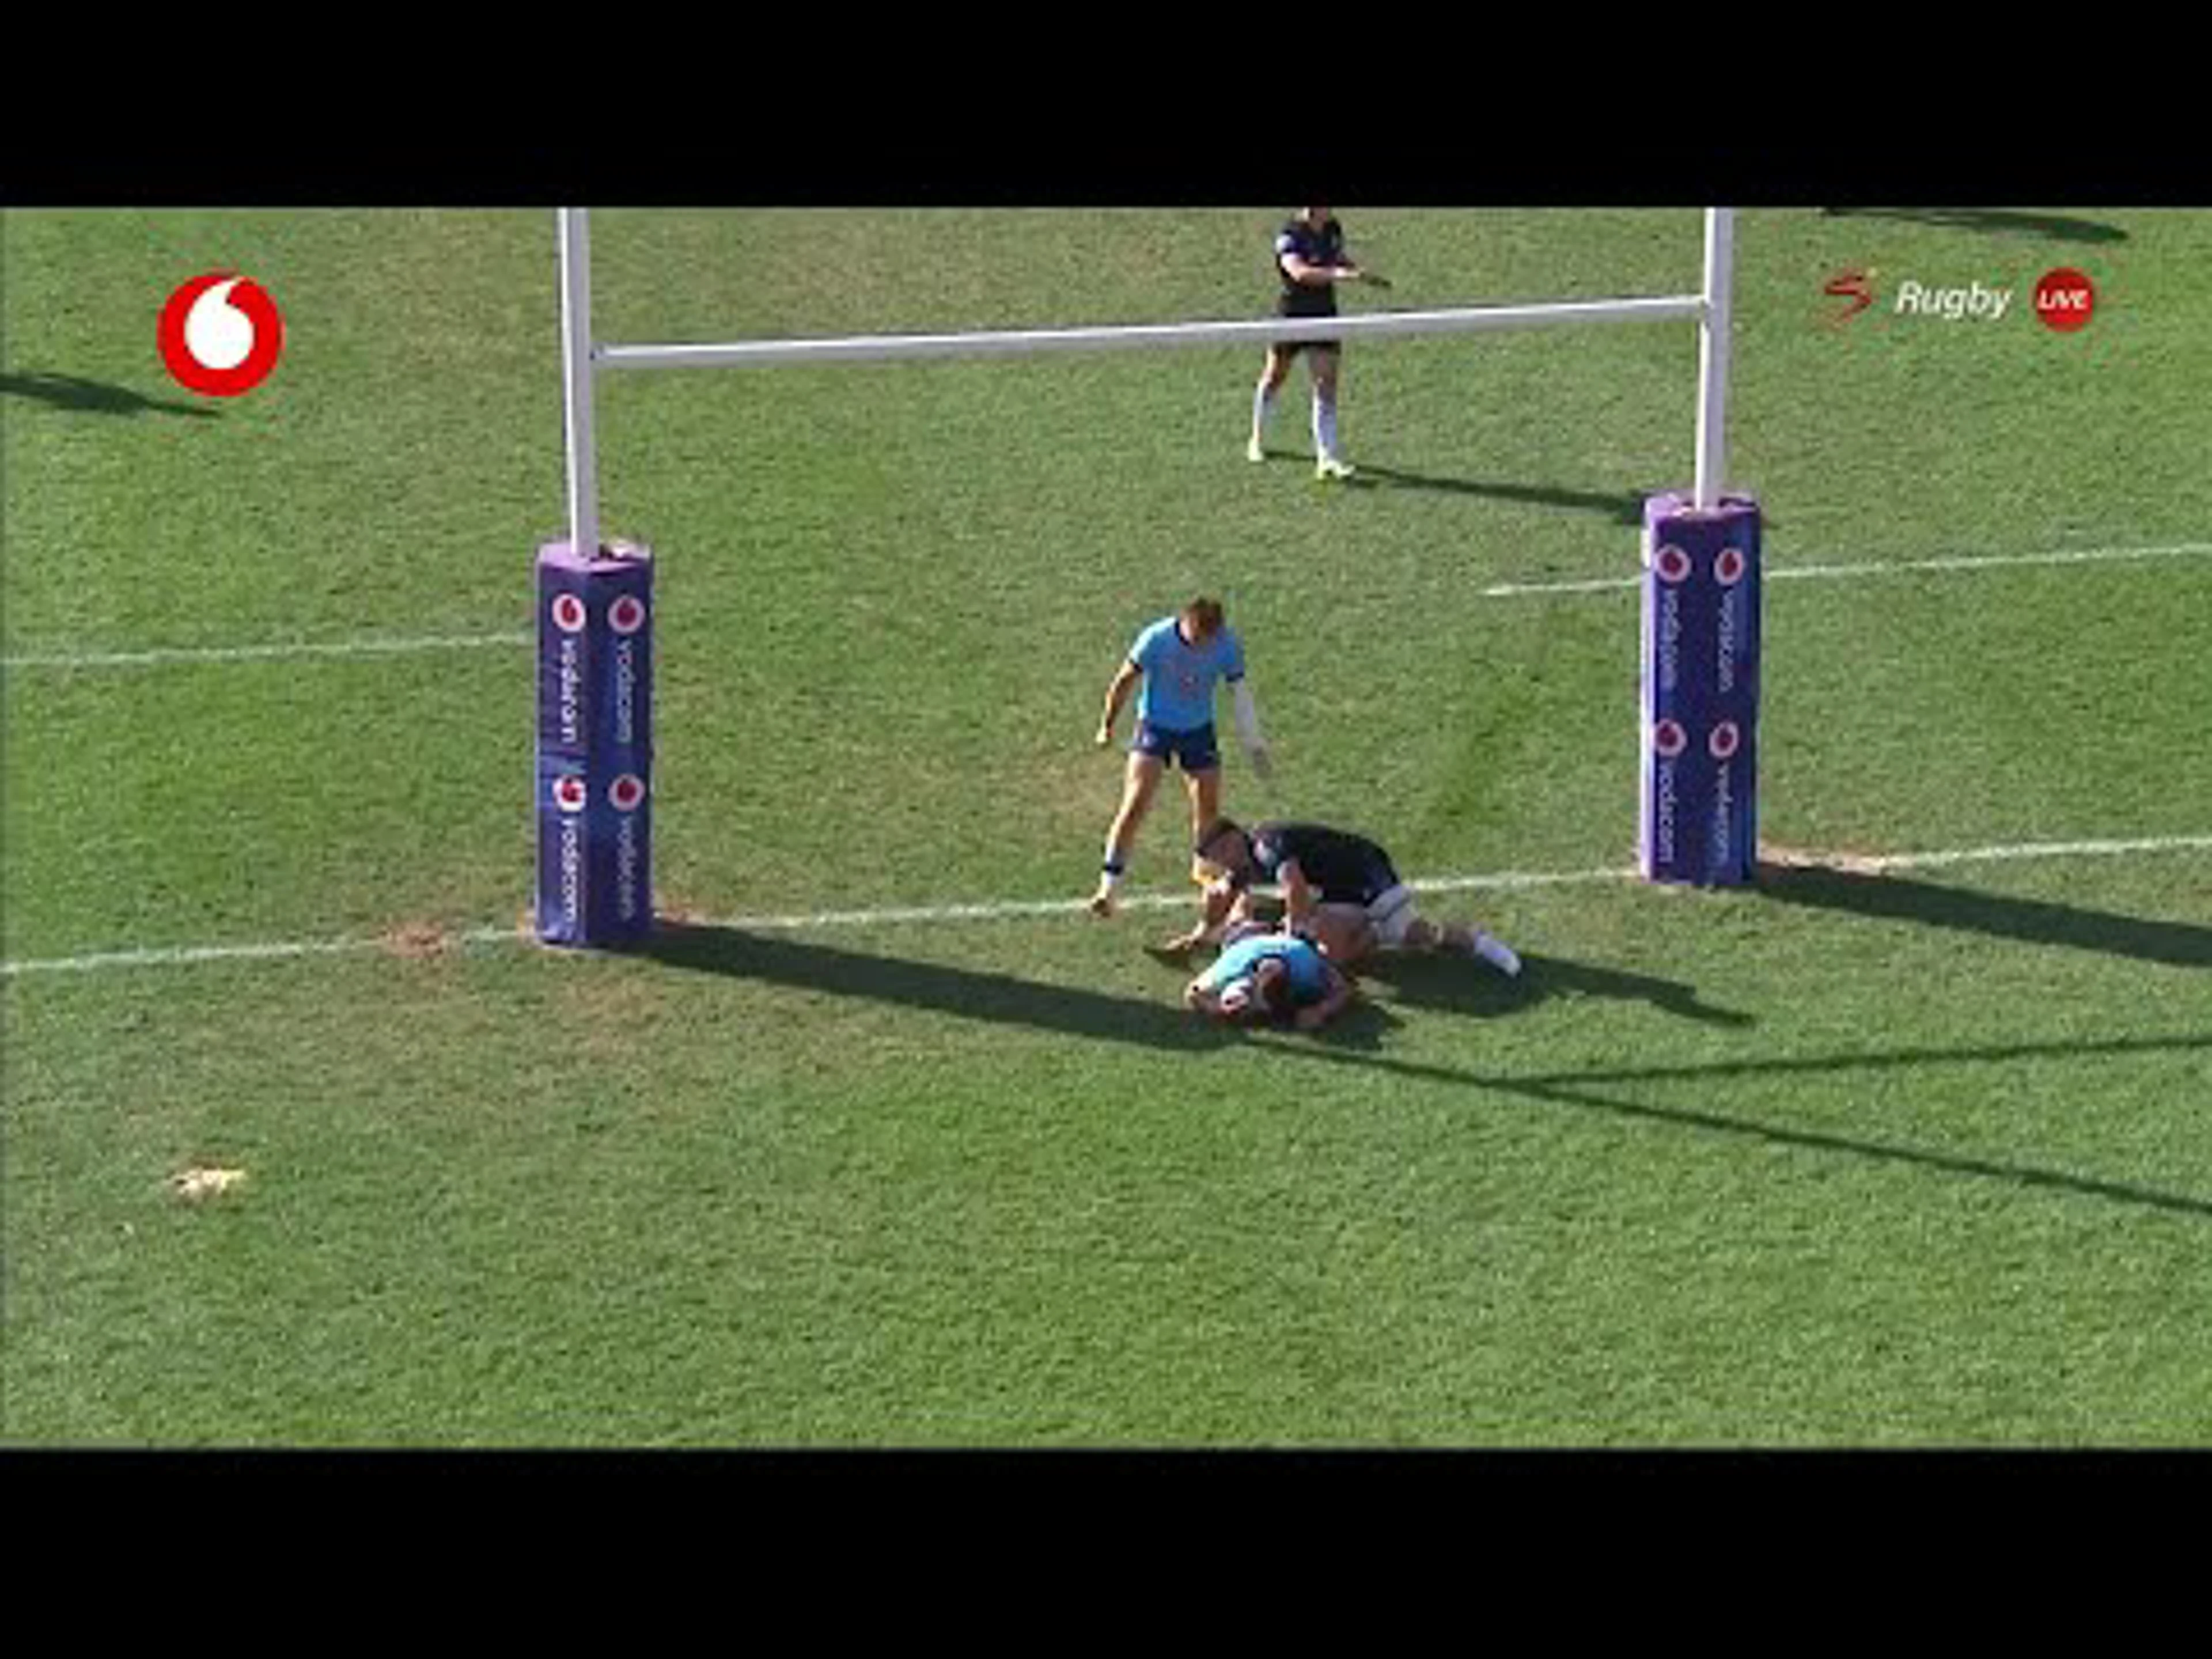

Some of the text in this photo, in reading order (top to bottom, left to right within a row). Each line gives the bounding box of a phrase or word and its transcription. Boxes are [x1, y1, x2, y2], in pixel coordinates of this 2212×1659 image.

[560, 640, 579, 743] vodacom
[616, 640, 636, 743] vodacom
[1658, 762, 1676, 862] vodacom
[561, 817, 579, 923] vodacom
